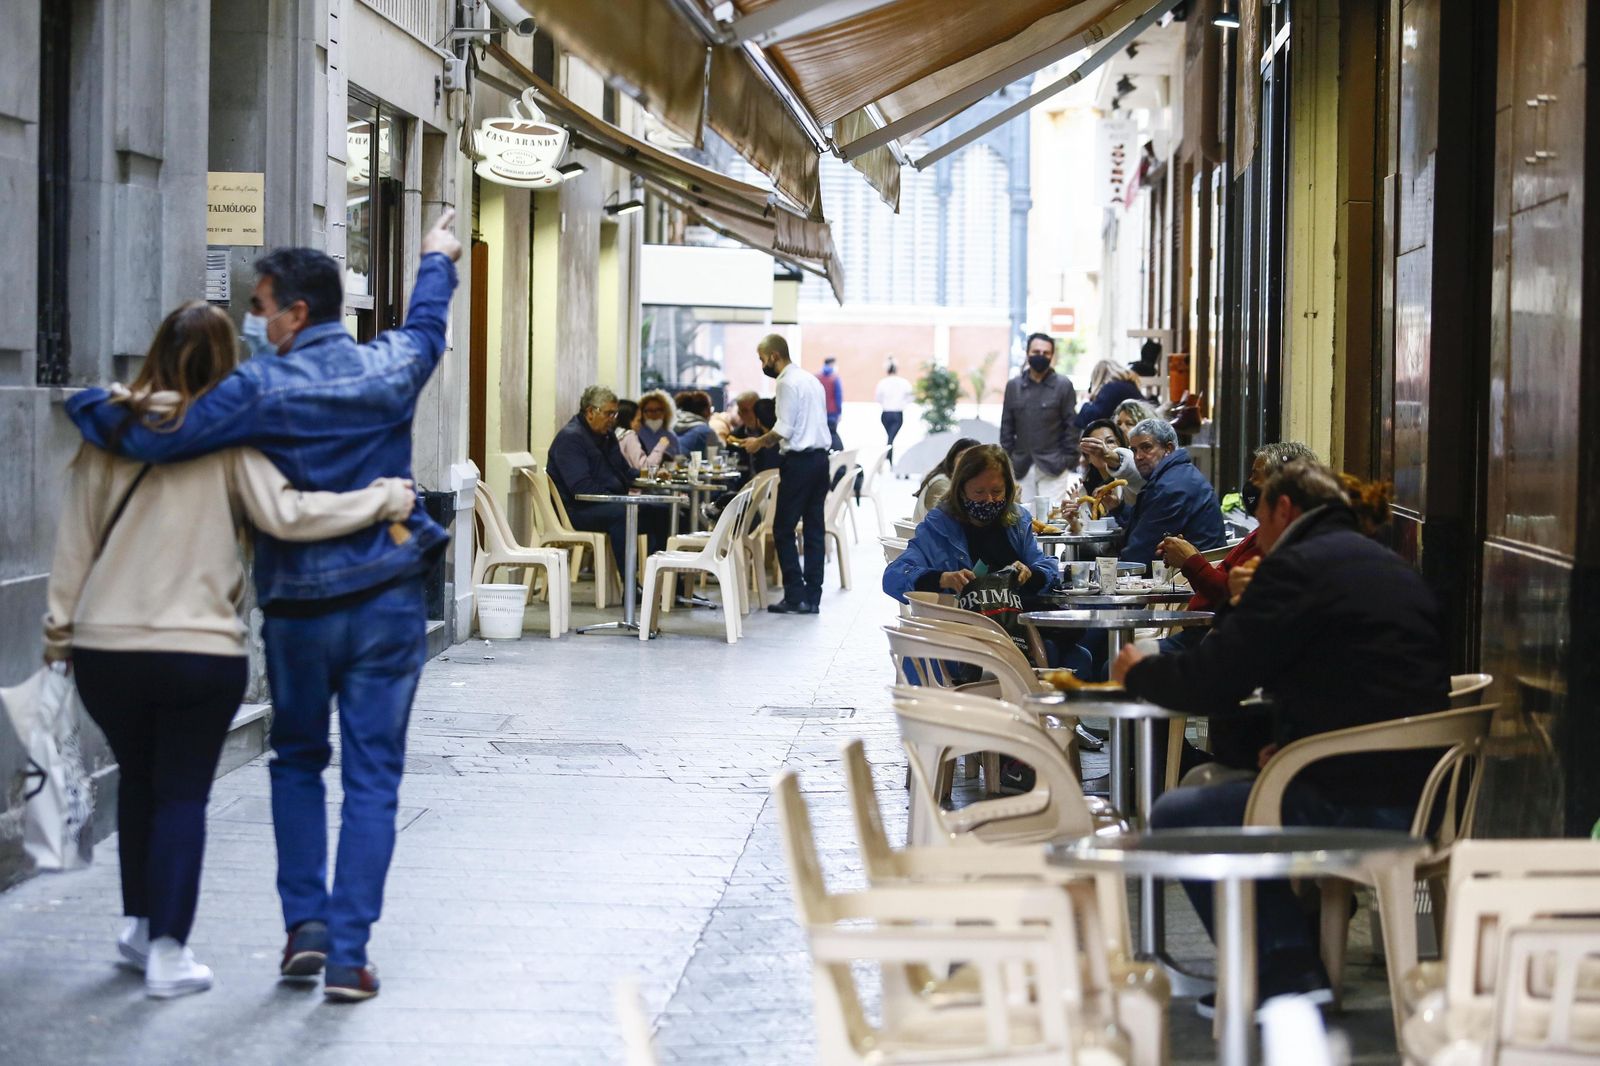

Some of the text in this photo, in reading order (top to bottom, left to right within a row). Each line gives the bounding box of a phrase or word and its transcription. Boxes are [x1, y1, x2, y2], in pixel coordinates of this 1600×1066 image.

[486, 130, 558, 147] CASA ARANDA
[208, 202, 257, 213] TALMÓLOGO
